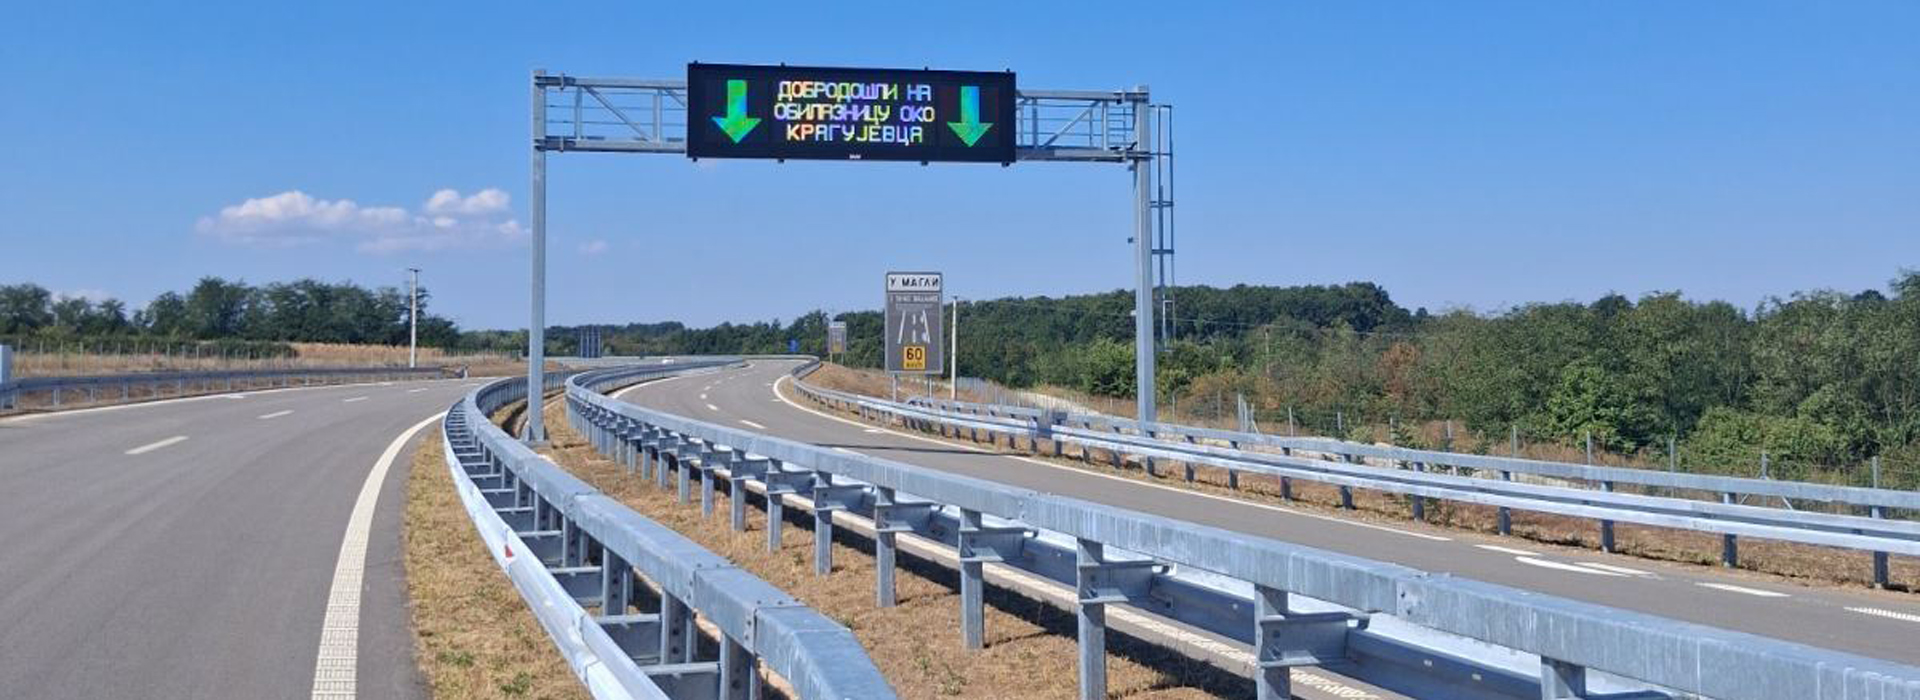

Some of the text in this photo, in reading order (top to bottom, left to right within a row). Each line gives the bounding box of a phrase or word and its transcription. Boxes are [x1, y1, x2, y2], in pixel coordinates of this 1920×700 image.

[777, 80, 932, 102] ДОБРОДОШЛИ НА
[774, 103, 935, 125] ОБИЛАЗНИЦУ ОКО
[786, 124, 922, 146] КРАГУЈЕВЦА
[889, 277, 939, 287] У МАГЛИ
[906, 347, 923, 361] 60
